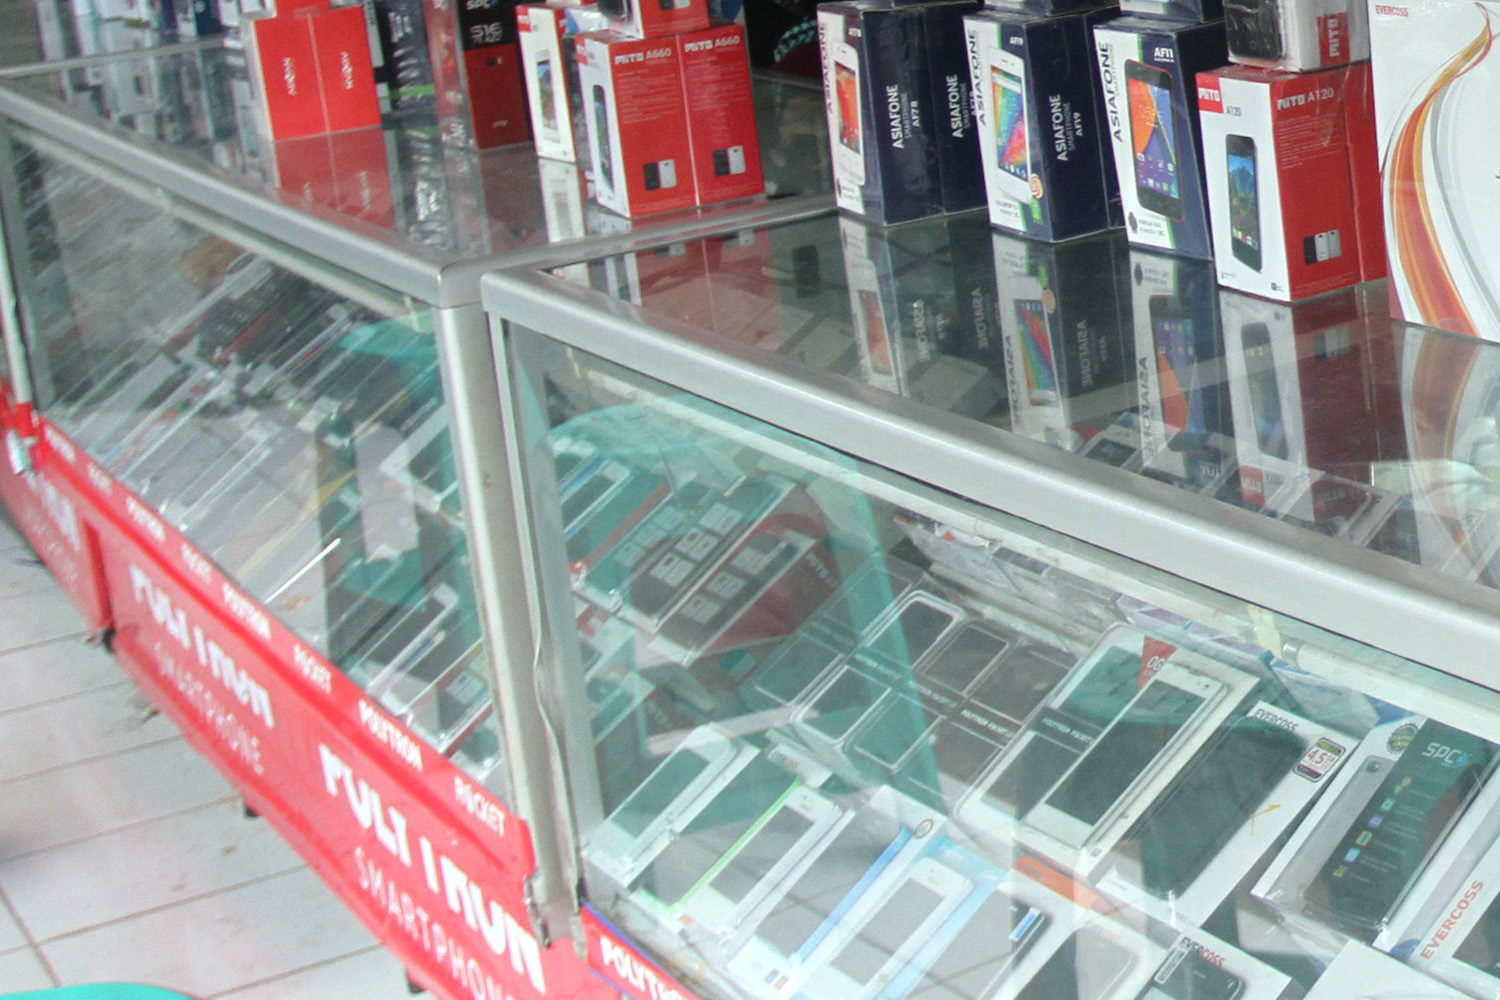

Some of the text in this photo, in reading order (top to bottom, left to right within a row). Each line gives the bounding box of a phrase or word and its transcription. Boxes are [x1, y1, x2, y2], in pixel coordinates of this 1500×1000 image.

[1375, 5, 1408, 17] EVERCOSS
[946, 74, 965, 139] ASIAFONE
[967, 29, 987, 127] ASIAFONE
[1099, 41, 1124, 143] ASIAFONE
[1199, 87, 1221, 102] MITO
[1277, 87, 1334, 110] MITO A120
[887, 83, 905, 149] ASIAFONE
[1049, 94, 1069, 162] ASIAFONE
[1226, 106, 1242, 117] A120
[358, 699, 423, 771] POLYTRON
[1255, 708, 1299, 731] EVERCOSS
[1422, 742, 1462, 765] SPC
[1421, 880, 1485, 960] EVERCOSS
